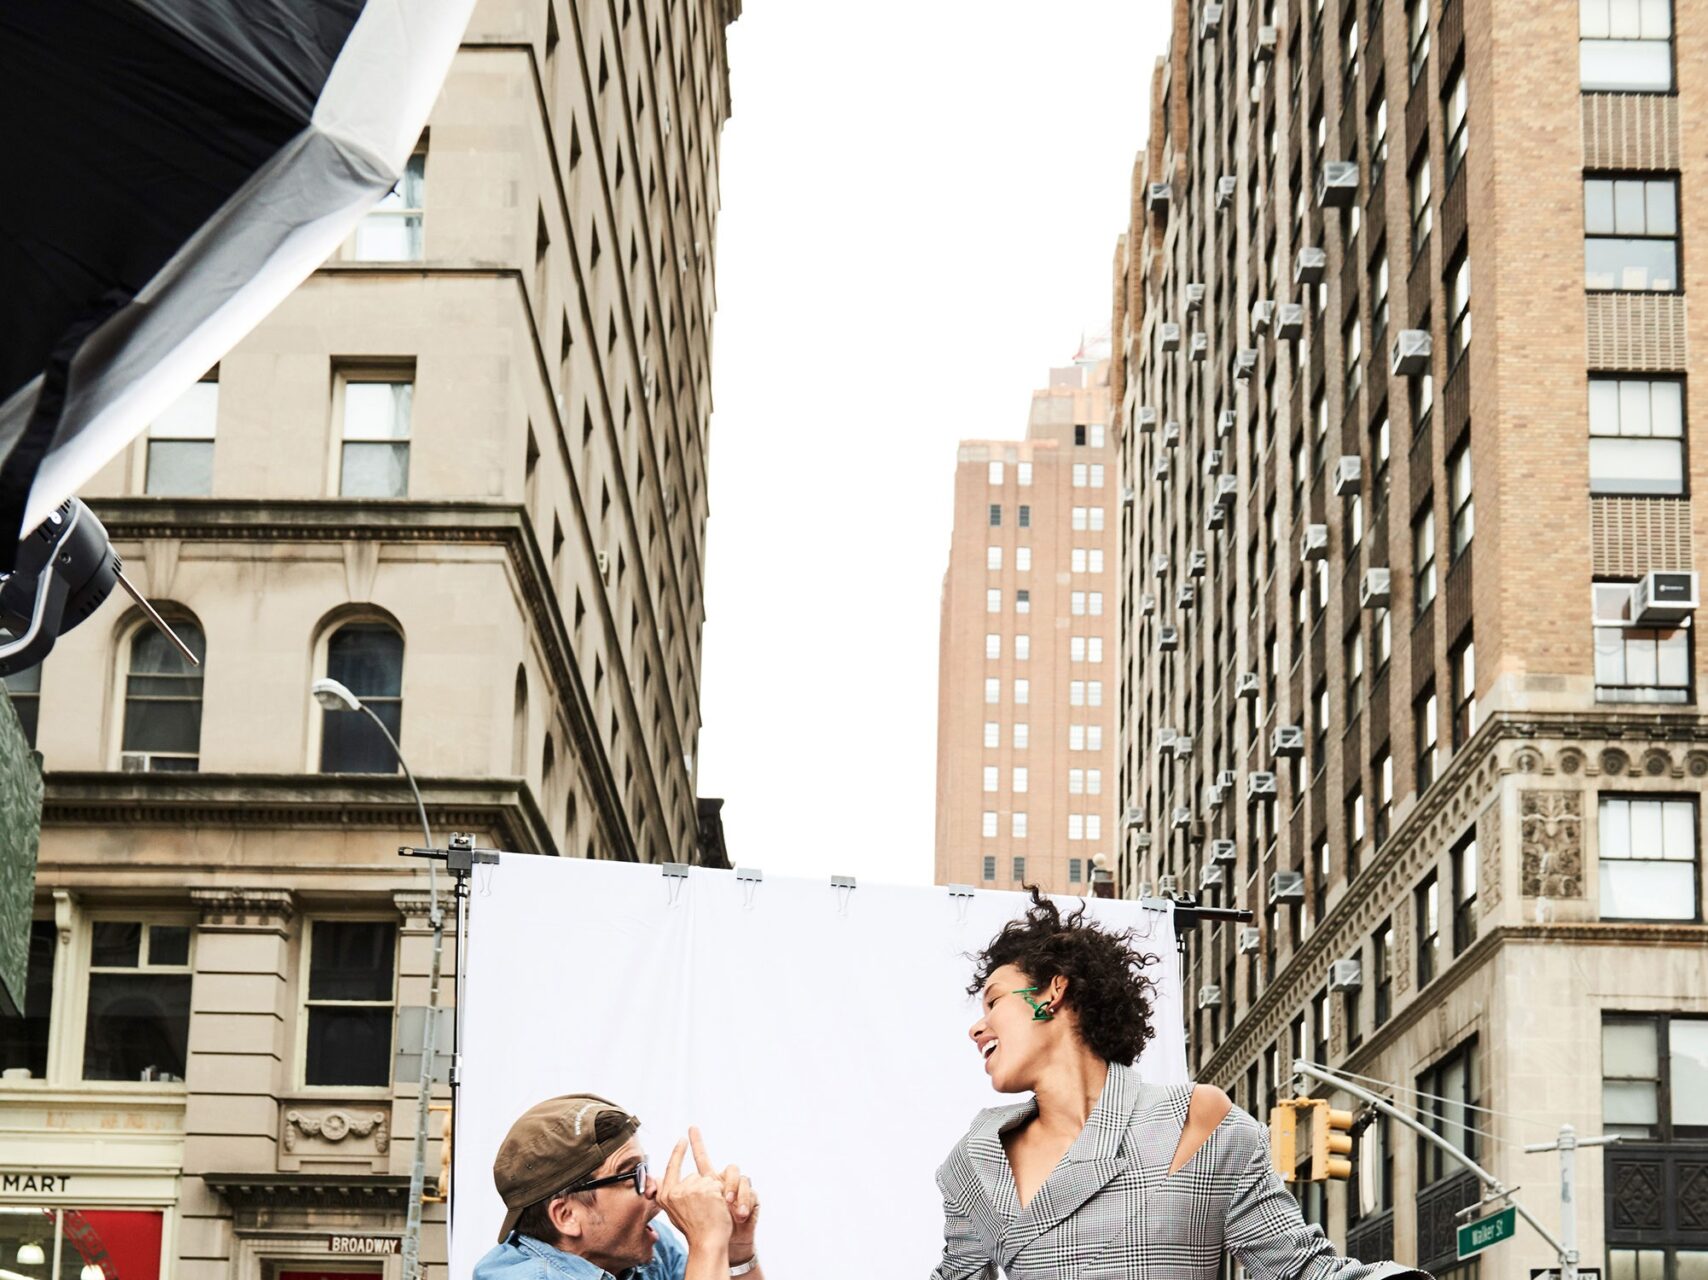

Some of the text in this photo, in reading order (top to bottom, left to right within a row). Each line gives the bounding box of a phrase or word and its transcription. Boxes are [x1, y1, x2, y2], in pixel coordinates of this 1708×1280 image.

[3, 1176, 70, 1192] MART
[1472, 1218, 1504, 1246] Walker St
[332, 1237, 398, 1253] BROADWAY
